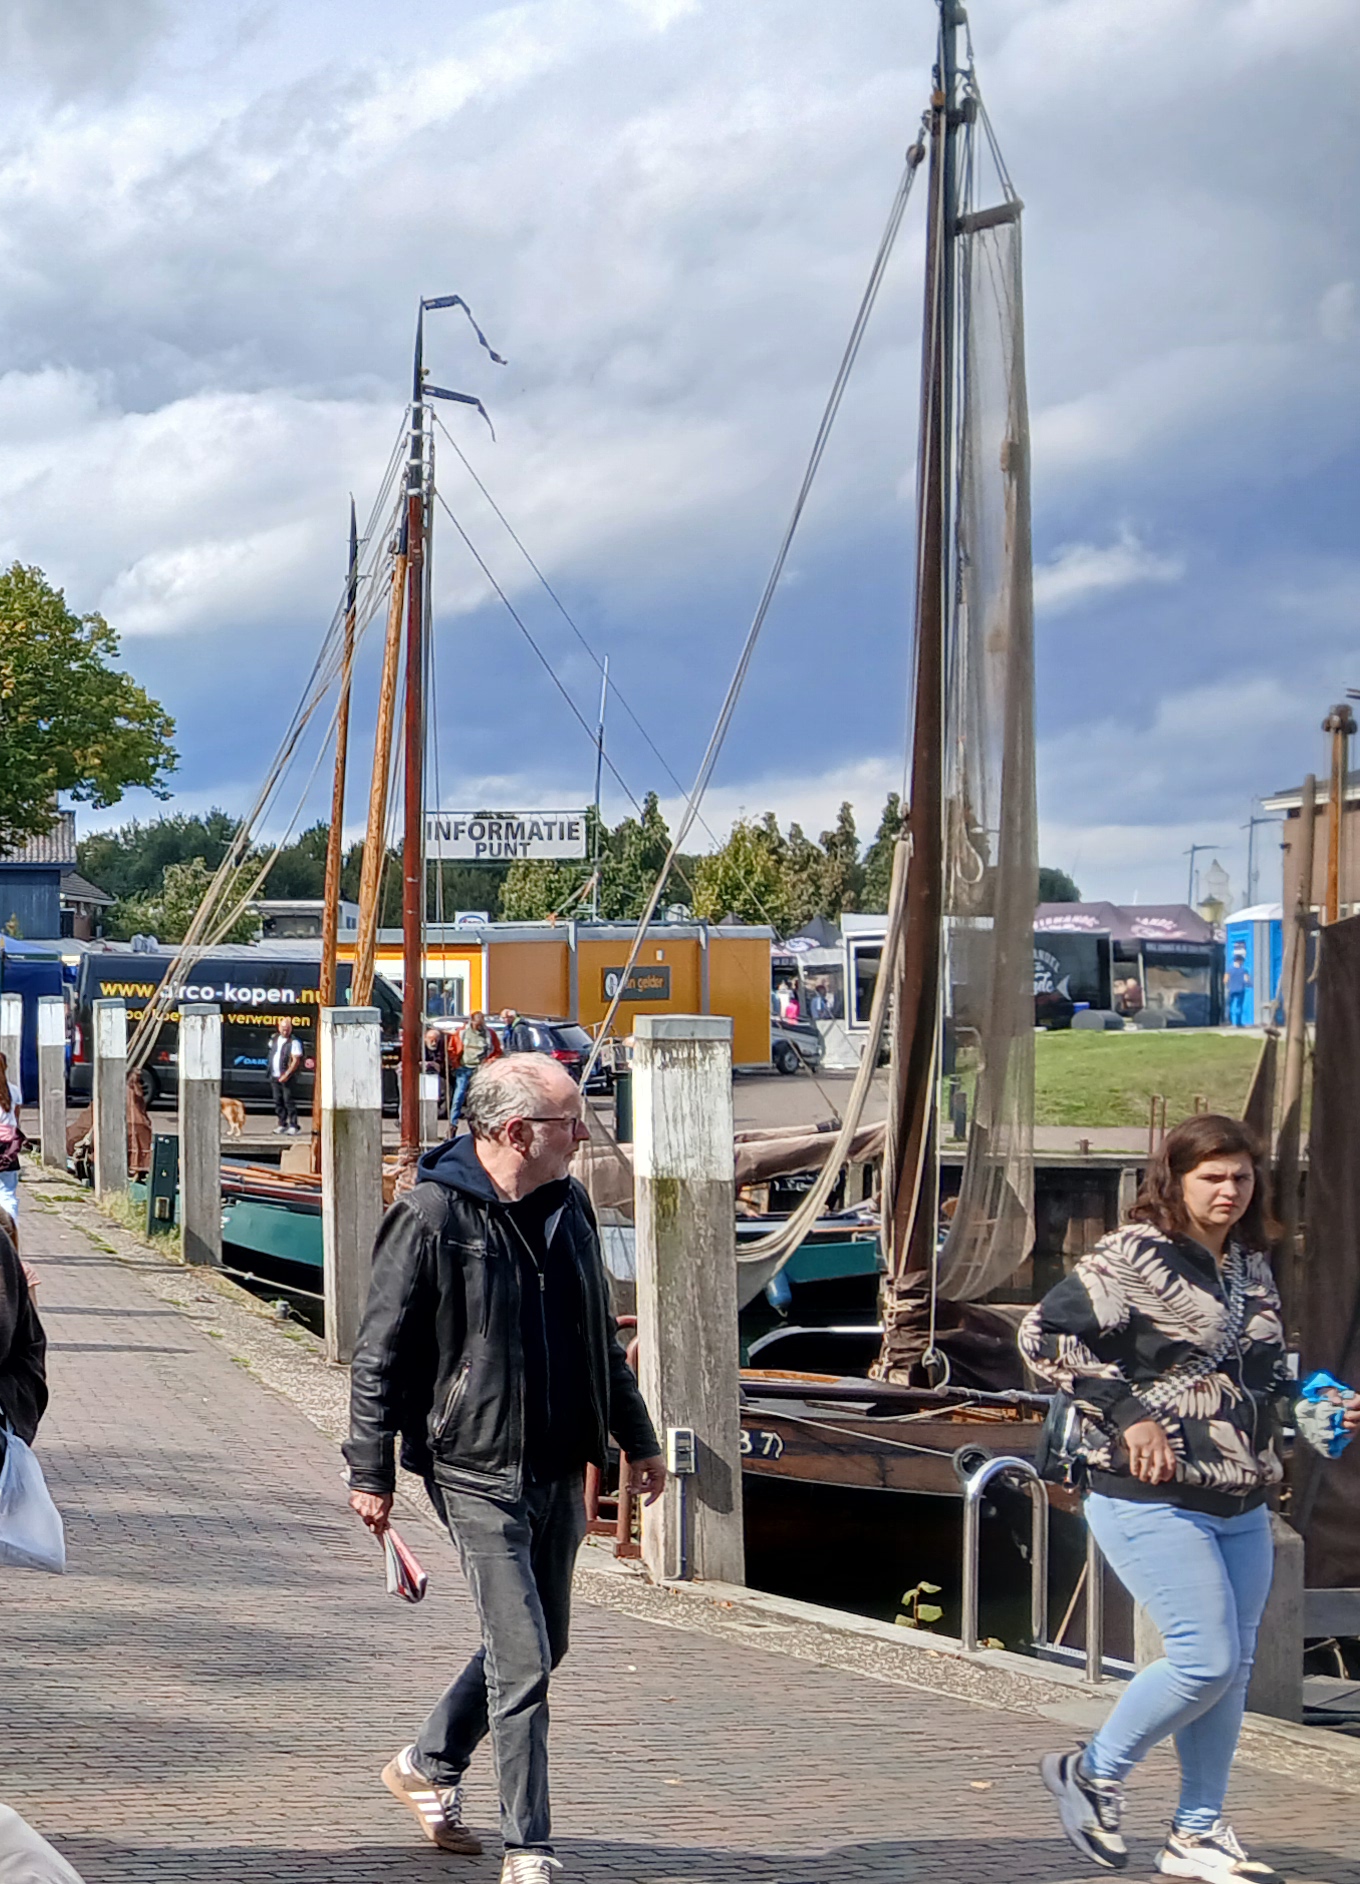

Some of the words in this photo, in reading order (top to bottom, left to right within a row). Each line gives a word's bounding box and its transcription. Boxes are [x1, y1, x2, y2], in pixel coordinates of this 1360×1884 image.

[427, 821, 580, 841] INFORMATIE
[475, 842, 531, 858] PUNT
[100, 981, 320, 1006] wwwarco-kopen.n
